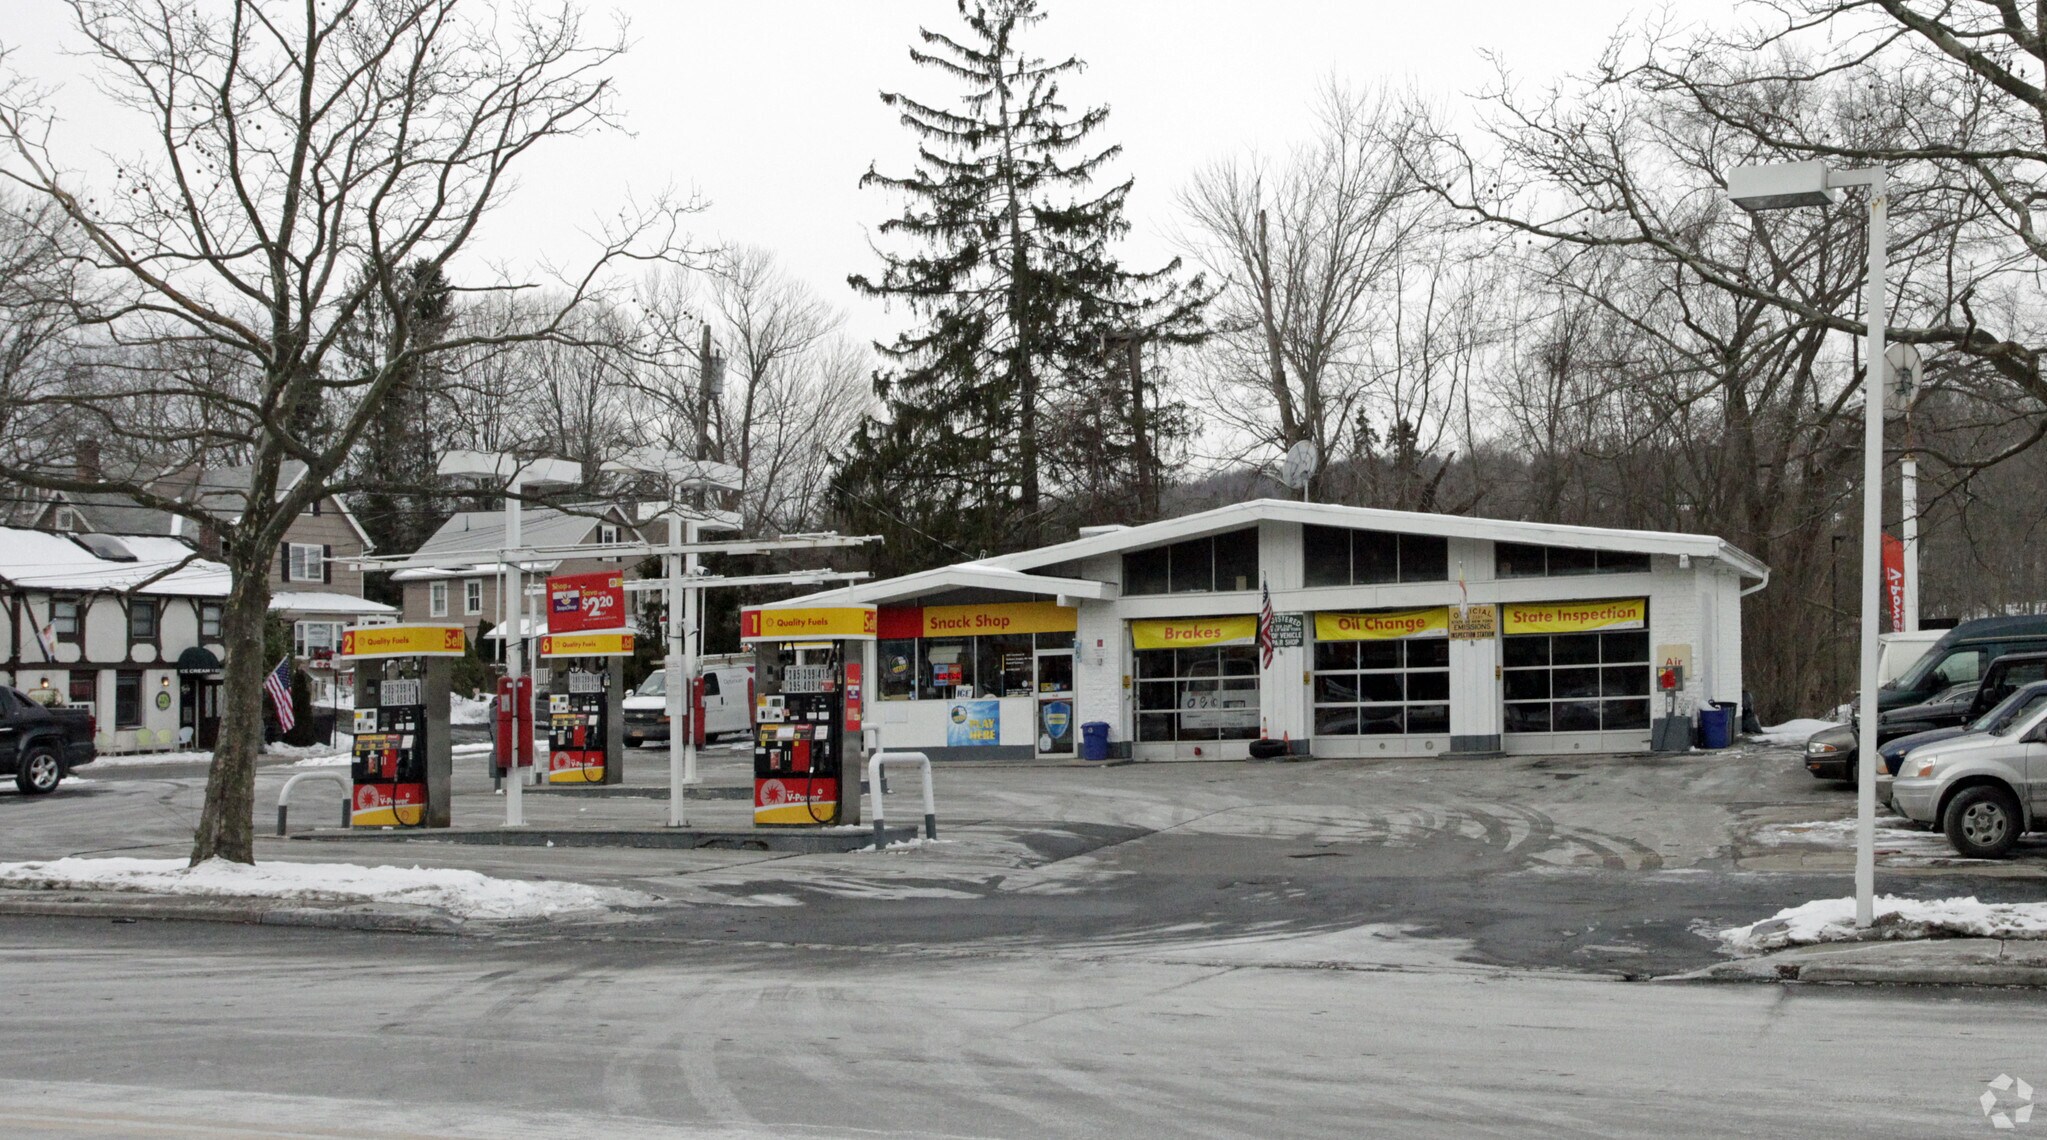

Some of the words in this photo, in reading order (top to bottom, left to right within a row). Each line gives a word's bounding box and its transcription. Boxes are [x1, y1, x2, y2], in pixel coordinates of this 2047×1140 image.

[551, 583, 567, 591] Shop
[1453, 607, 1492, 619] OICIAL
[1513, 610, 1553, 623] State
[1558, 605, 1637, 624] Inspection
[751, 614, 758, 633] 1
[777, 619, 806, 628] Quality
[808, 618, 828, 626] Fuels
[930, 615, 971, 629] Snack
[975, 614, 1010, 629] Shop
[1338, 617, 1360, 631] Oil
[1364, 617, 1425, 632] Change
[1453, 623, 1492, 631] EMISSIONS
[1164, 625, 1221, 640] Brakes
[1450, 631, 1476, 639] INSPECTION
[344, 635, 353, 653] 2
[367, 637, 390, 647] Quality
[542, 639, 550, 652] 6
[1665, 657, 1683, 666] Air
[957, 689, 972, 698] ICE
[969, 718, 995, 728] PLAY
[969, 730, 996, 740] HERE
